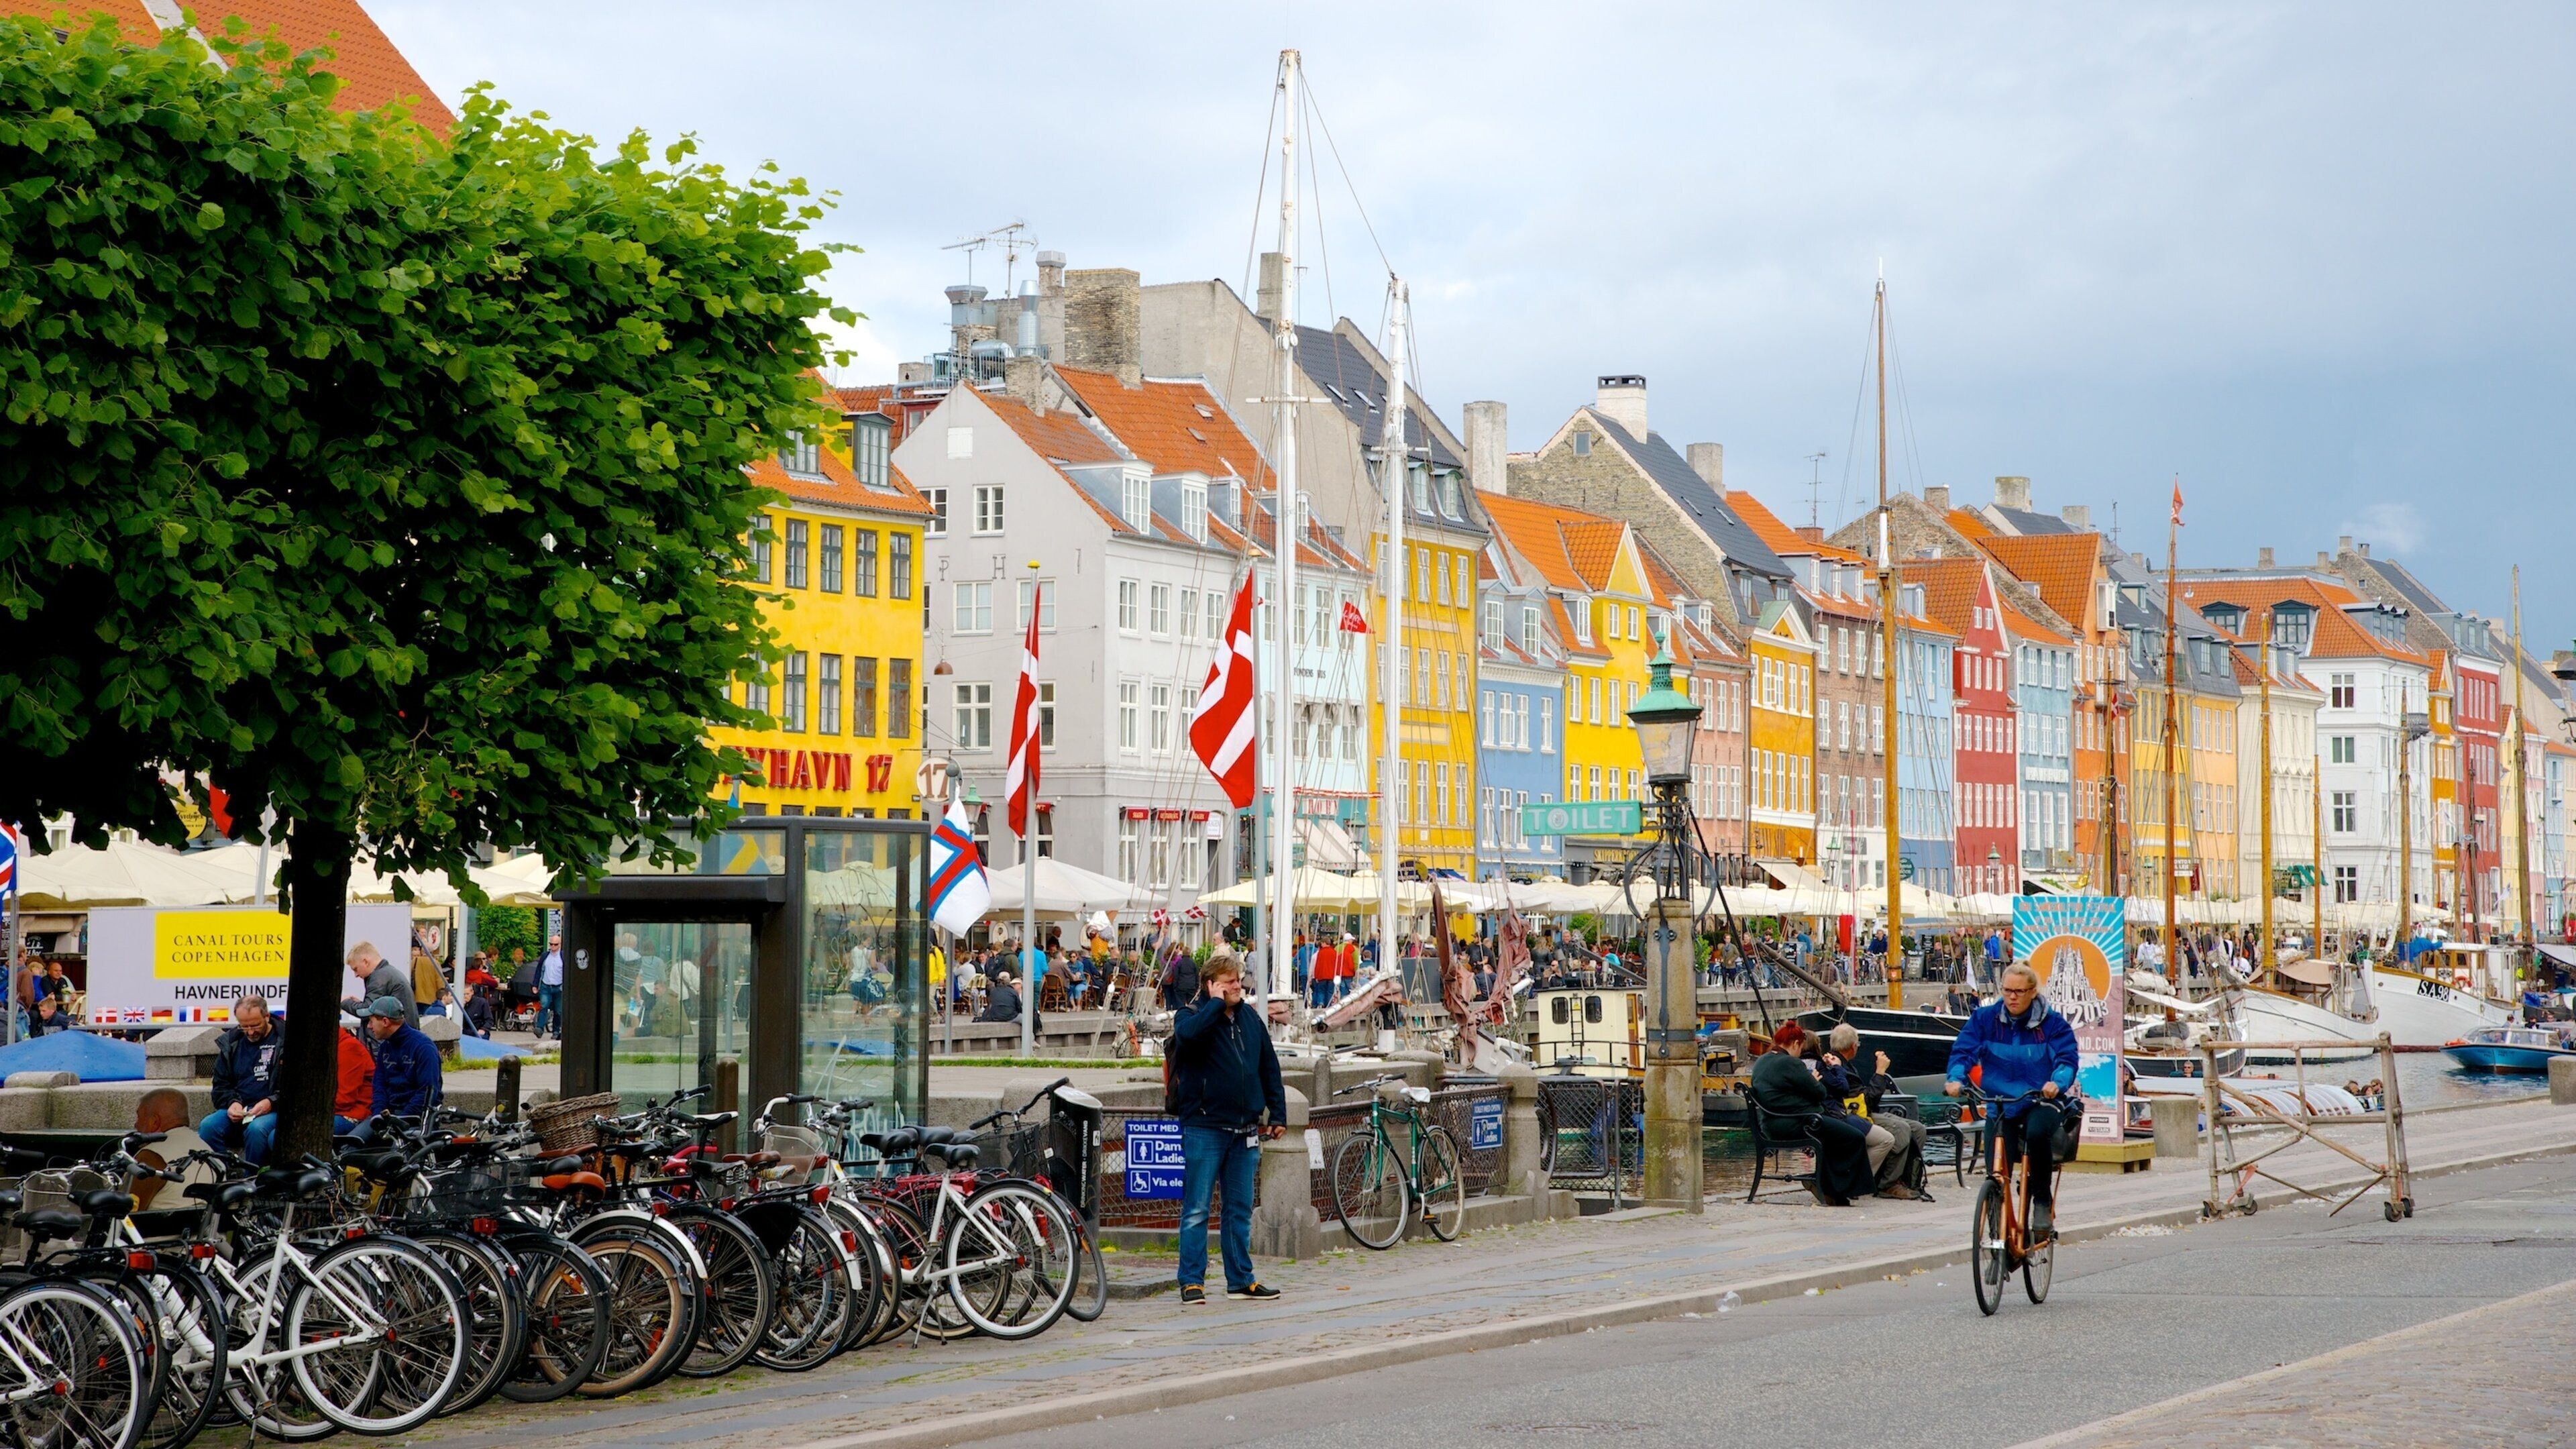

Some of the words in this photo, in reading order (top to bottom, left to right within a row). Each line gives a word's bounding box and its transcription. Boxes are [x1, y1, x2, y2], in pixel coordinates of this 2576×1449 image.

[722, 745, 853, 792] YHAVN
[865, 754, 893, 793] 17
[918, 762, 948, 798] 17
[1527, 806, 1633, 830] TOILET
[174, 934, 227, 947] CANAL
[231, 934, 283, 945] TOURS
[172, 950, 284, 963] COPENHAGEN
[174, 985, 288, 1000] HAVNERUNDF
[2079, 1036, 2115, 1052] ND.COM
[1128, 1124, 1159, 1132] TOILET
[1160, 1124, 1179, 1132] MED
[1155, 1140, 1181, 1151] Dam
[1155, 1152, 1185, 1163] Ladie
[1152, 1177, 1167, 1187] Via
[1169, 1178, 1183, 1187] ele
